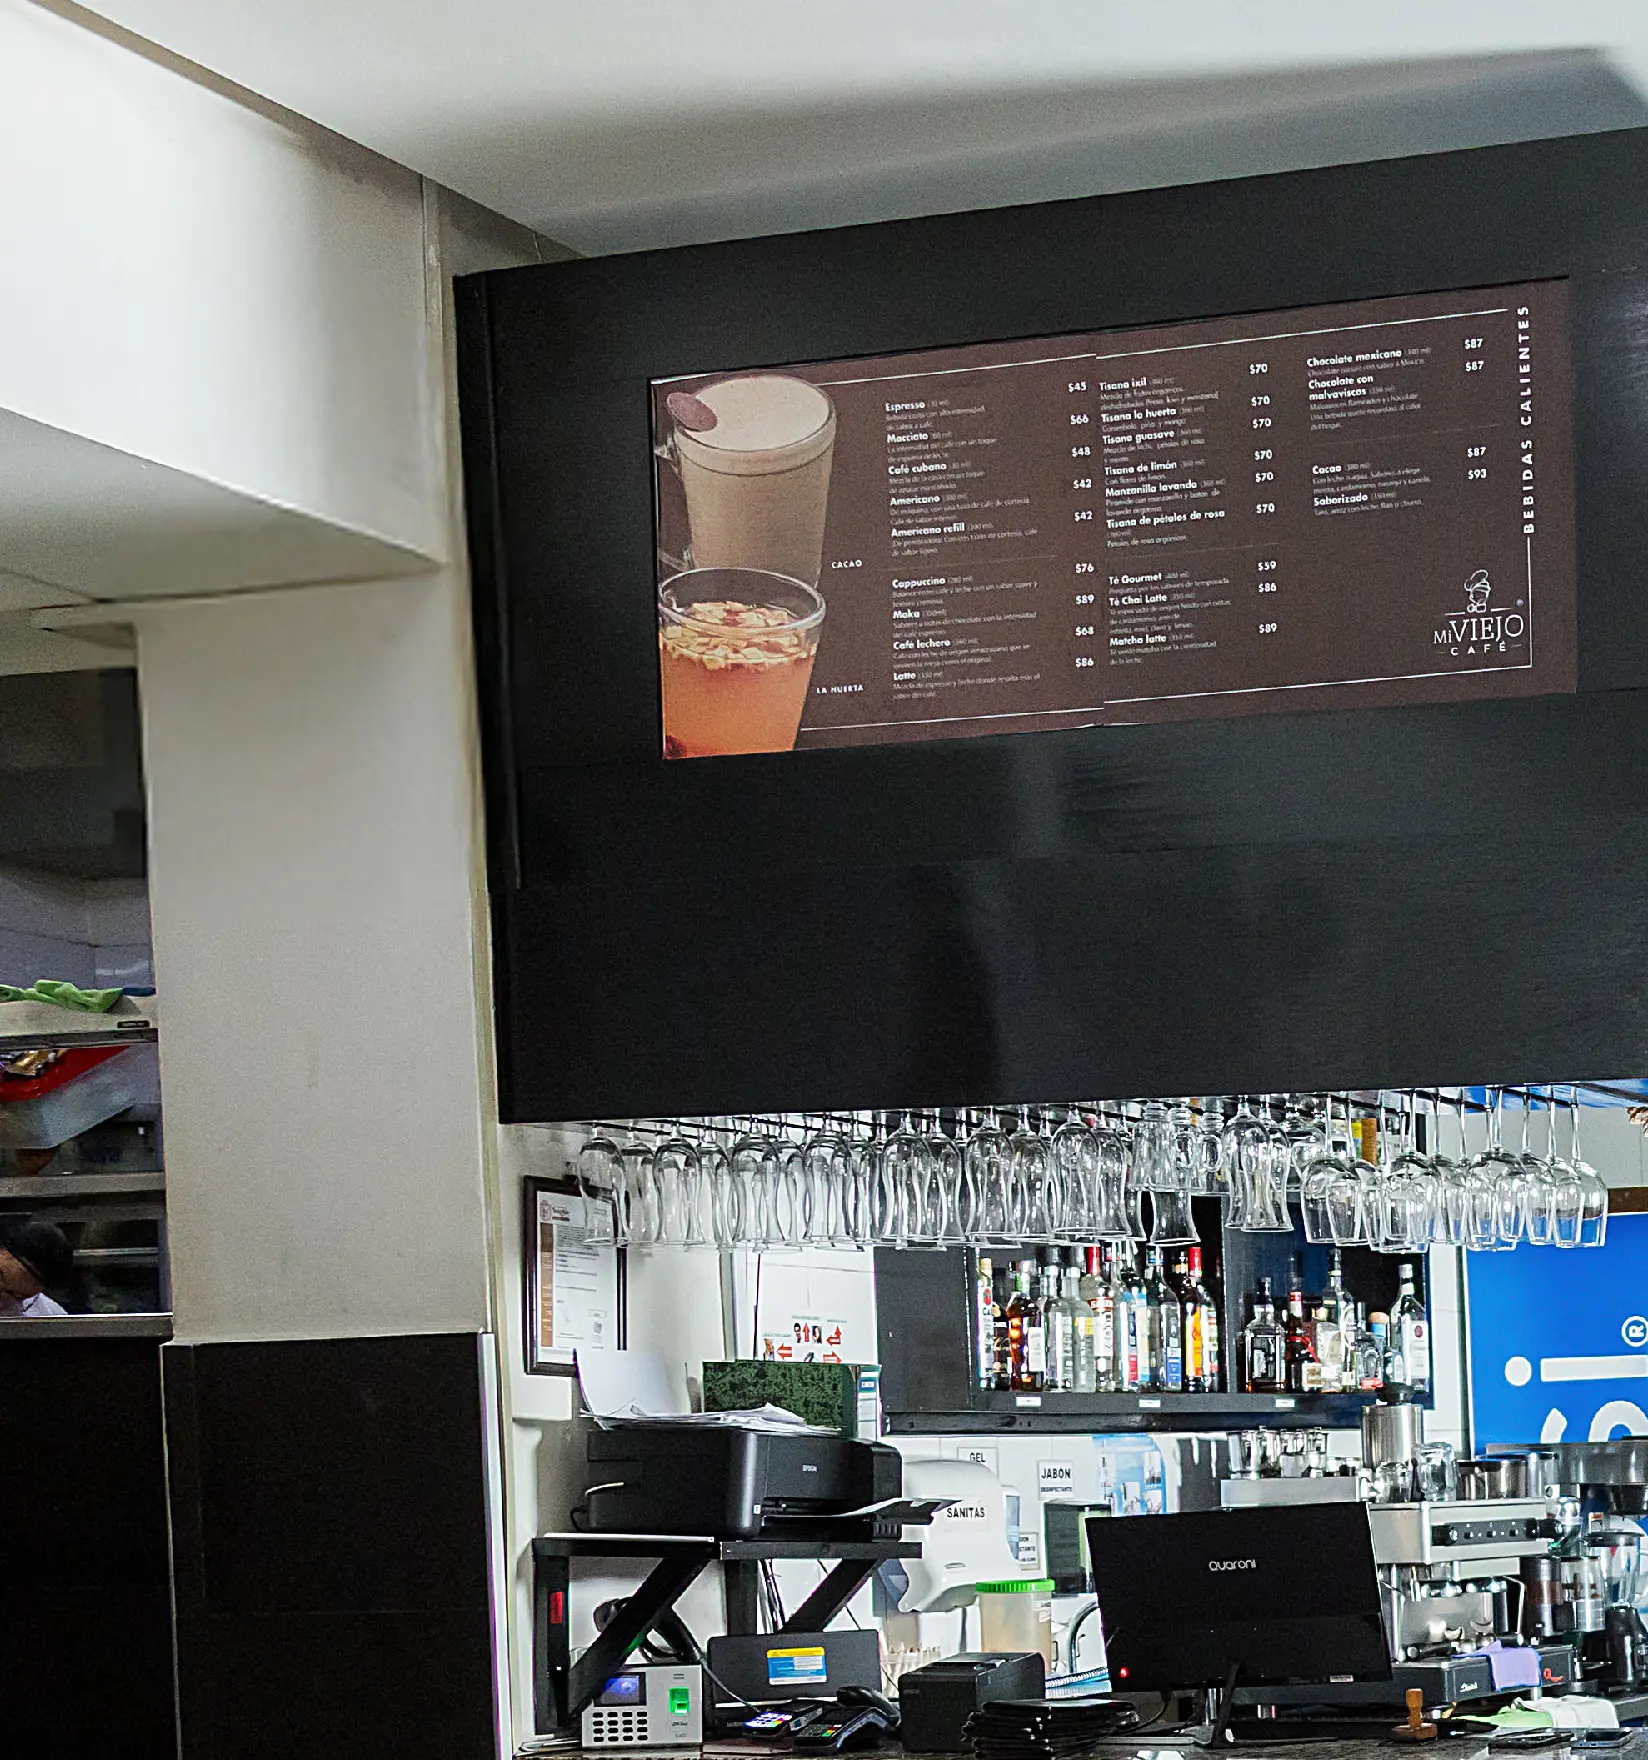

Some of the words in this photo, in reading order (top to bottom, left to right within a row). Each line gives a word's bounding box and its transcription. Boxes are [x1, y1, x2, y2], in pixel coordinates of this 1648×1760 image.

[1464, 338, 1484, 350] $87
[1307, 355, 1353, 367] Chocolate
[1465, 361, 1485, 372] $87
[1518, 306, 1532, 426] CALIENTES
[1249, 363, 1268, 375] $70
[1068, 381, 1088, 393] $45
[1100, 381, 1130, 391] Tisana
[1308, 377, 1355, 389] Chocolate
[1357, 375, 1374, 384] con
[1309, 387, 1367, 400] malvaviscos
[885, 401, 926, 413] Espresso
[1251, 395, 1271, 407] $70
[1070, 415, 1089, 425] $66
[1101, 412, 1132, 423] Tisana
[1145, 407, 1177, 418] huerta
[1252, 418, 1272, 429] $70
[886, 432, 929, 444] Macciato
[1102, 434, 1133, 445] Tisana
[1135, 430, 1175, 445] guasave
[1072, 447, 1092, 458] $48
[1254, 449, 1273, 461] $70
[1467, 446, 1487, 458] $87
[888, 465, 909, 475] Café
[911, 462, 947, 473] cubano
[1104, 465, 1135, 476] Tisana
[1136, 463, 1149, 473] de
[1150, 460, 1178, 472] limón
[1312, 464, 1342, 475] Cacao
[1468, 468, 1487, 480] $93
[1255, 471, 1274, 483] $70
[1073, 479, 1092, 489] $42
[1105, 484, 1157, 497] Manzanilla
[1158, 481, 1198, 492] lavanda
[1521, 440, 1535, 534] BEBIDAS
[890, 495, 941, 506] Americano
[1313, 492, 1369, 506] Saborizado
[1256, 503, 1275, 514] $70
[1074, 511, 1093, 522] $42
[1106, 518, 1137, 529] Tisana
[1138, 516, 1152, 526] de
[1189, 510, 1202, 520] de
[1203, 509, 1225, 519] rosa
[891, 526, 942, 538] Americano
[943, 522, 966, 534] refill
[831, 559, 863, 569] CACAO
[1075, 563, 1095, 574] $76
[1257, 560, 1277, 572] $59
[892, 577, 946, 590] Cappuccino
[1108, 576, 1120, 586] Té
[1121, 572, 1162, 584] Gourmet
[1258, 582, 1277, 593] $86
[1075, 594, 1095, 605] $89
[1109, 597, 1120, 607] Té
[1121, 595, 1143, 606] Chai
[1145, 593, 1168, 605] Latte
[892, 609, 920, 619] Moka
[1075, 626, 1095, 637] $68
[1258, 623, 1278, 634] $89
[1450, 614, 1525, 643] VIEJO
[893, 640, 914, 650] Café
[916, 638, 951, 649] lechero
[1110, 636, 1144, 647] Matcha
[1145, 633, 1167, 644] latte
[1450, 641, 1507, 657] CAFÉ
[1075, 658, 1095, 668] $86
[893, 671, 917, 681] Latte
[830, 684, 864, 694] HUERTA
[969, 1452, 986, 1463] GEL
[1041, 1468, 1071, 1479] JABON
[946, 1507, 985, 1518] SANITAS
